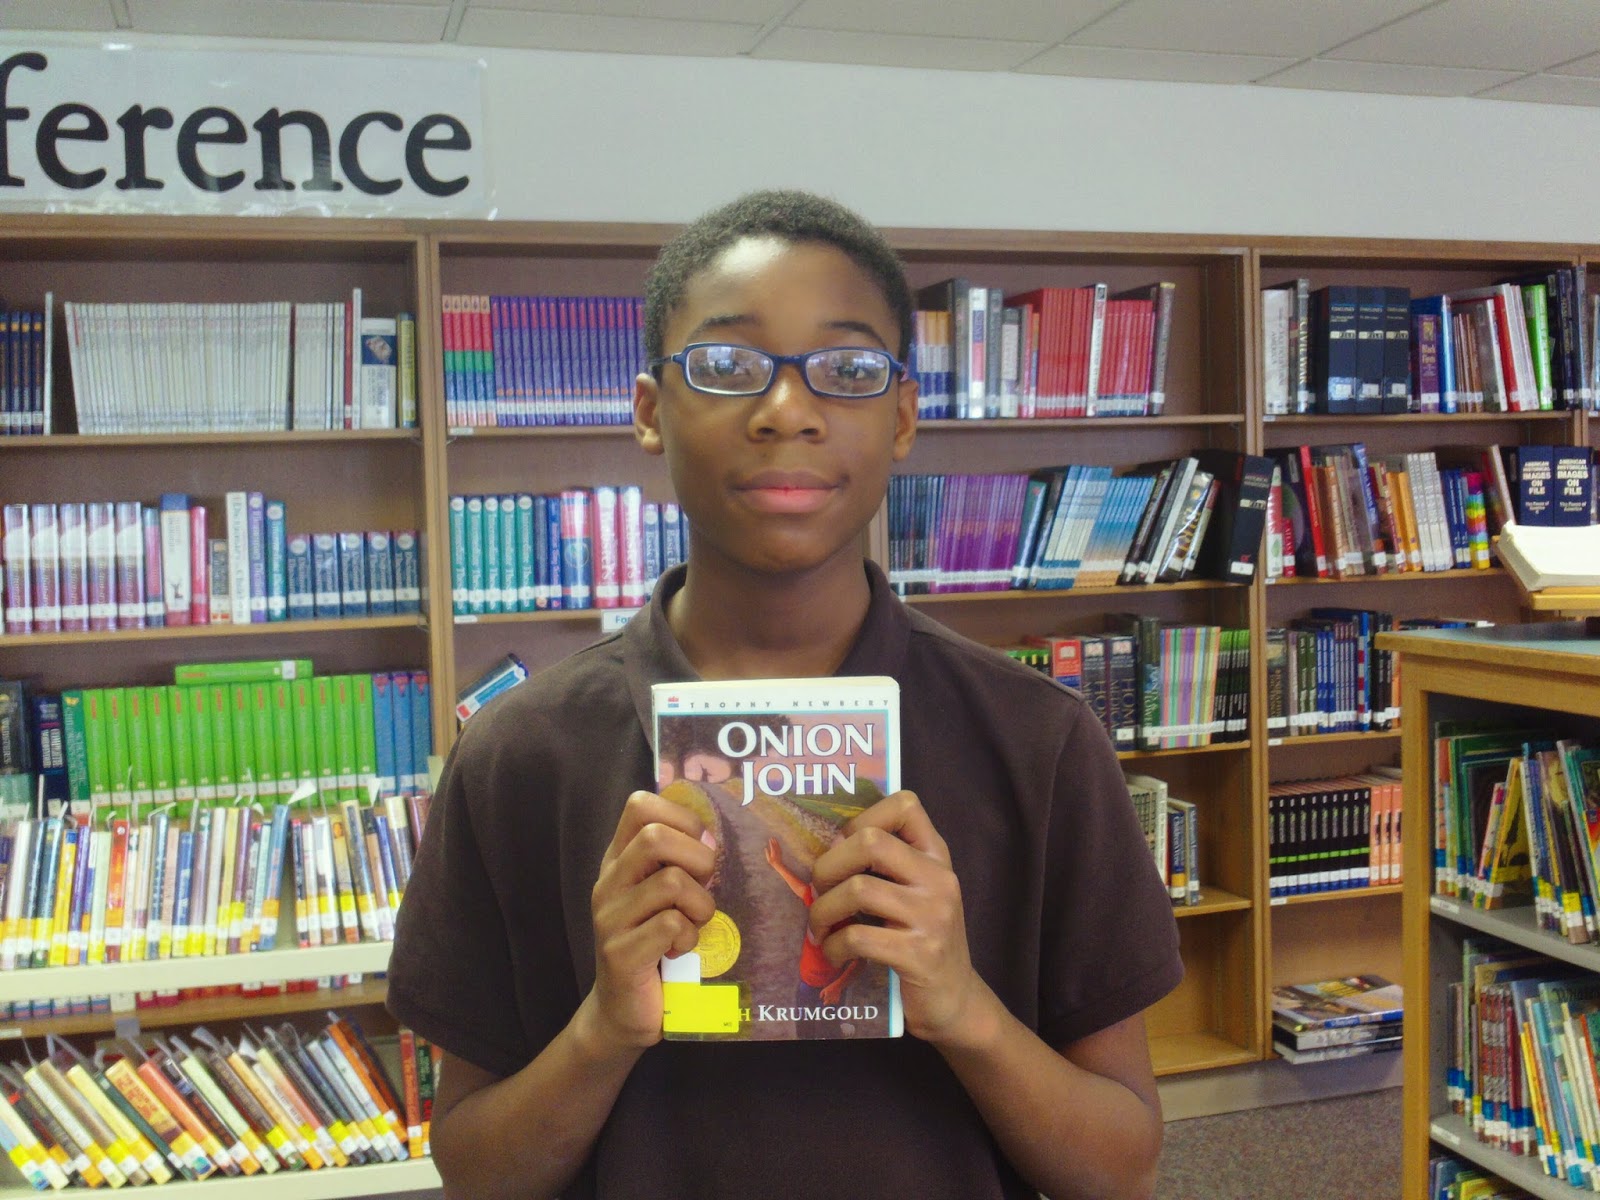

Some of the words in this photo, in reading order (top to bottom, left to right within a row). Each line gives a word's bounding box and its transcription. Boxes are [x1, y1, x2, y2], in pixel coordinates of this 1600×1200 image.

[1522, 471, 1551, 480] IMAGES
[1557, 470, 1589, 479] IMAGES
[1531, 479, 1543, 487] ON
[1566, 479, 1580, 487] ON
[1528, 486, 1546, 495] FILE
[1563, 486, 1583, 495] FILE
[645, 531, 655, 555] Basic
[666, 529, 676, 555] Basic
[690, 701, 771, 709] TROPHY
[792, 699, 889, 708] NEWBERY
[1110, 680, 1119, 728] MEDICA
[1143, 695, 1153, 727] FLOWER
[717, 721, 875, 758] ONION
[741, 760, 857, 808] JOHN
[758, 1005, 879, 1022] KRUMGOLD
